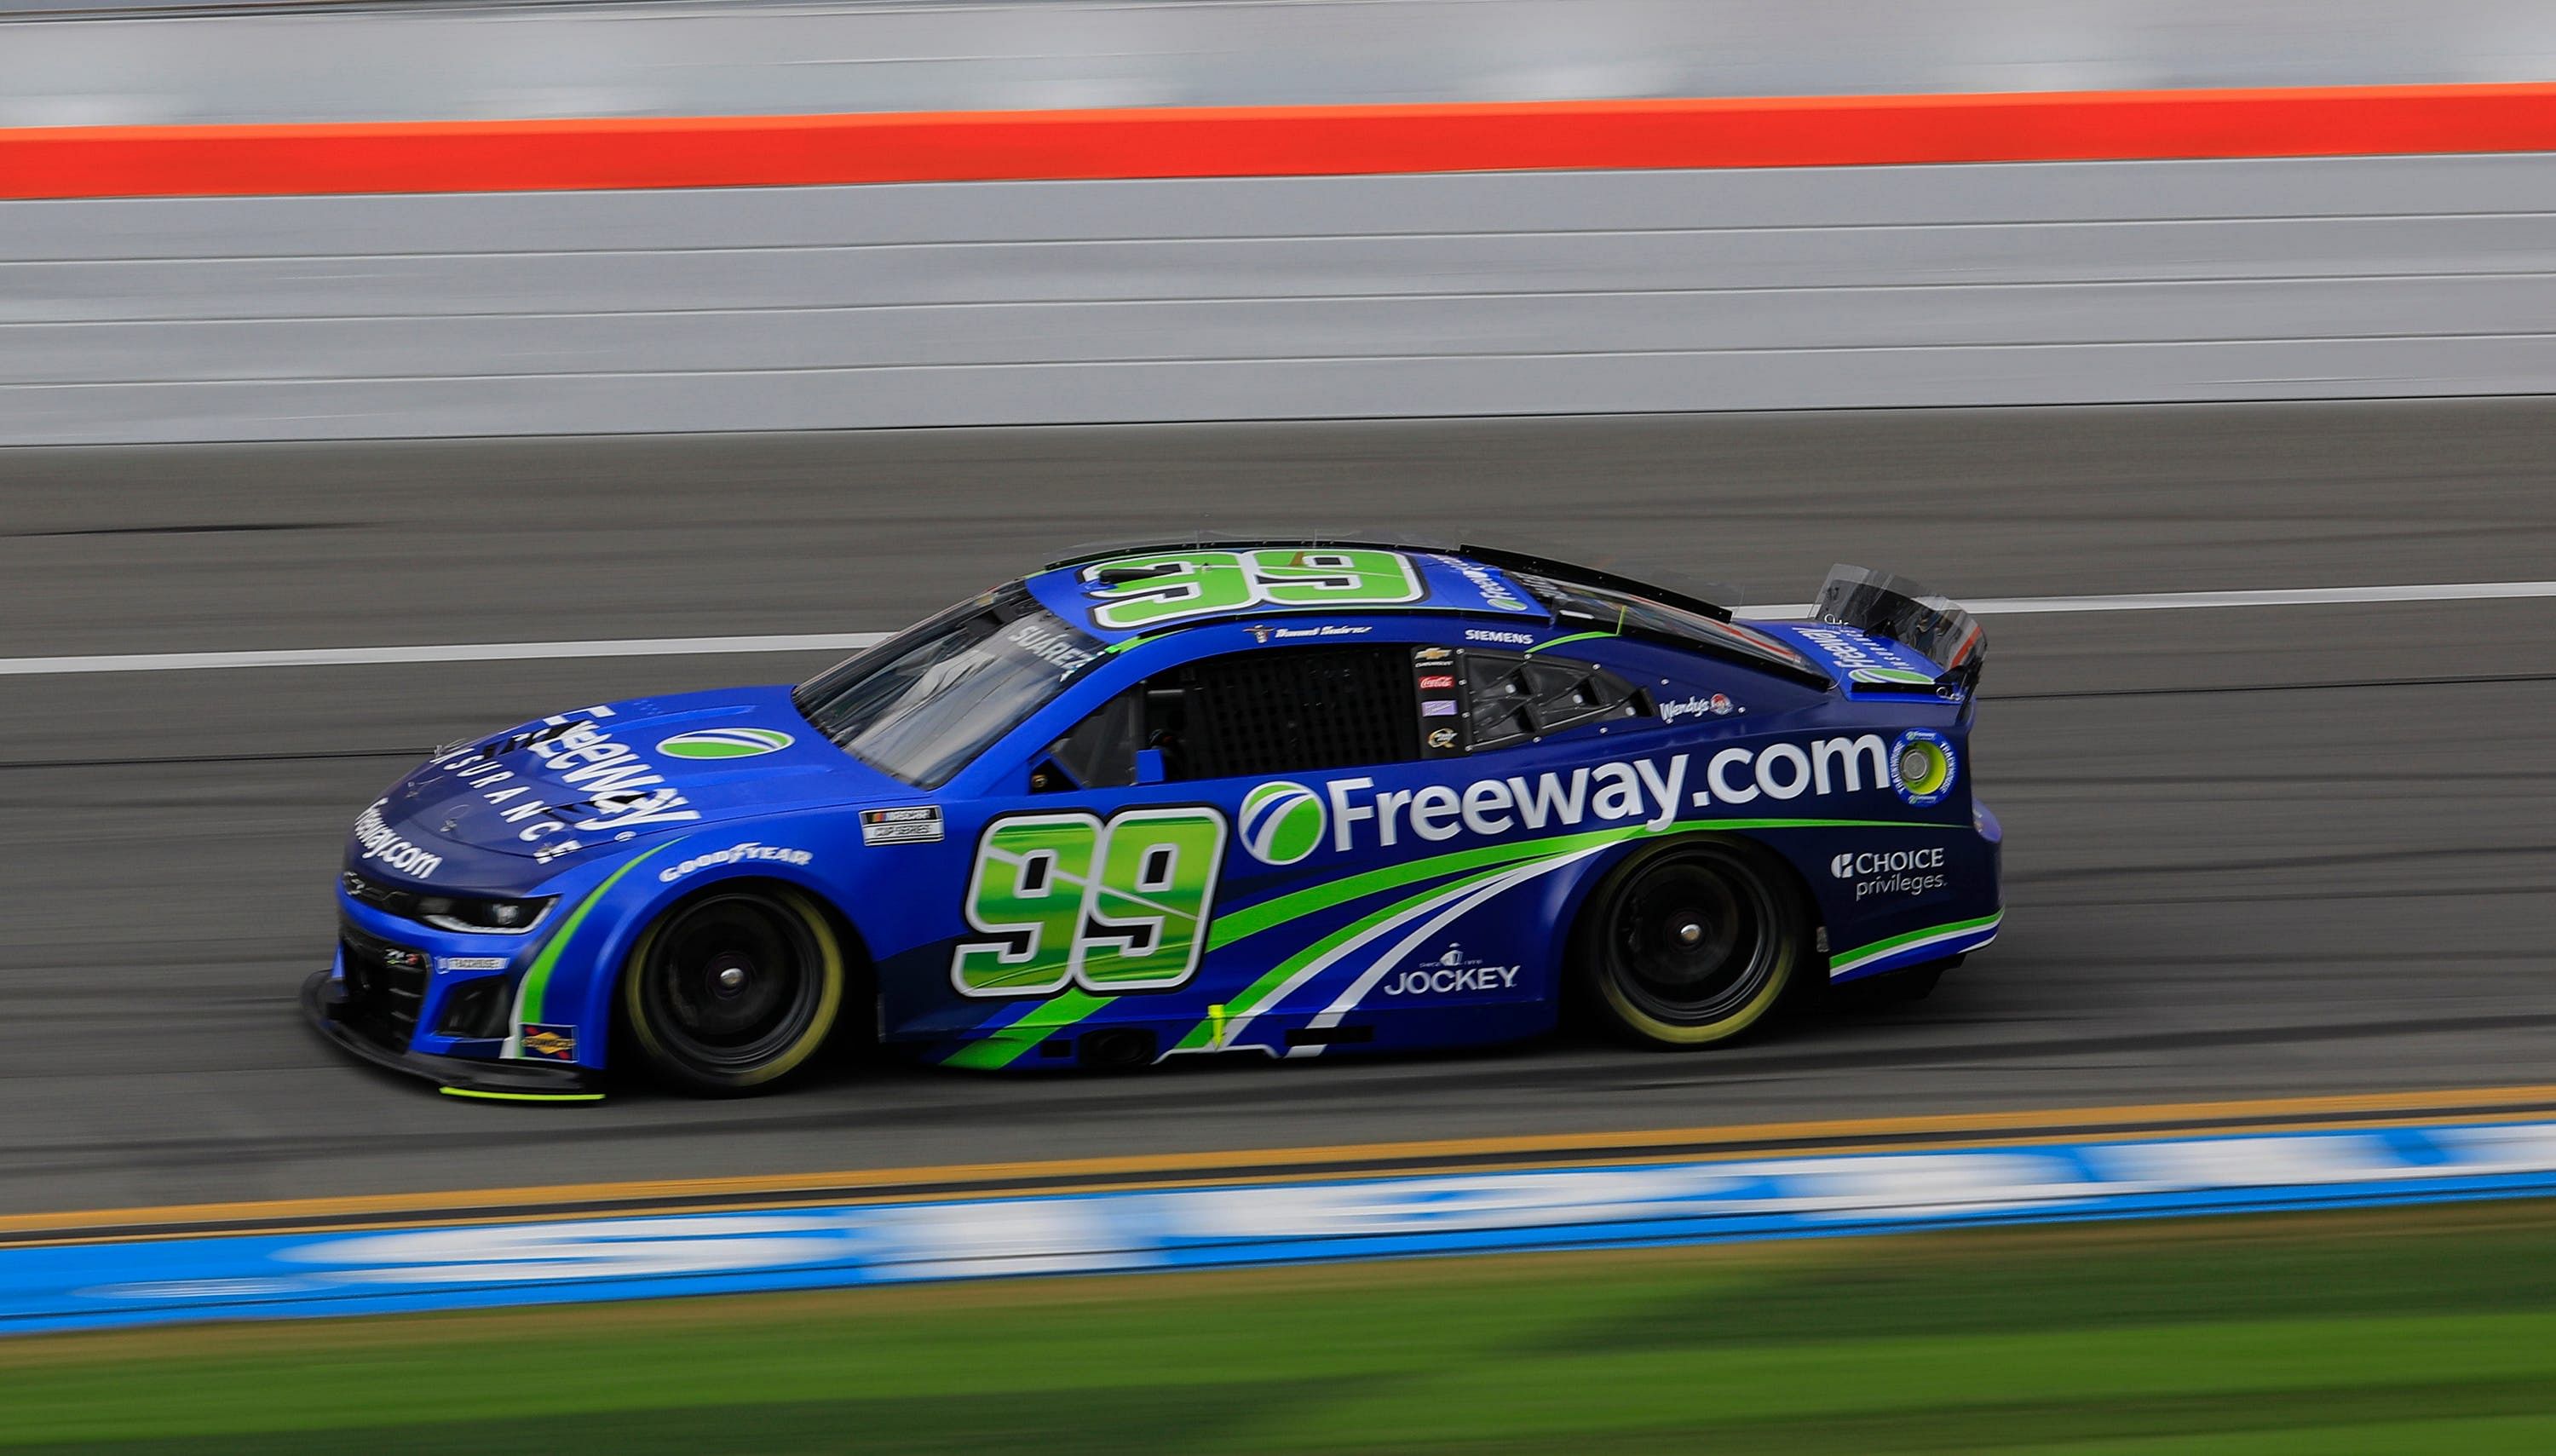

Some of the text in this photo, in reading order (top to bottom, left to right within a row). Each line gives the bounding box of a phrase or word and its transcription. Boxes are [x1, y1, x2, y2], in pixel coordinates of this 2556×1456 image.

[1465, 629, 1534, 645] SIEMENS
[1659, 695, 1709, 721] Wendy's
[1325, 734, 1890, 852] Freeway.com
[354, 797, 443, 879] Freeway.com
[659, 841, 814, 883] GOODYEAR
[1855, 847, 1945, 875] CHOICE
[950, 804, 1229, 1001] 99
[1383, 964, 1521, 996] JOCKEY
